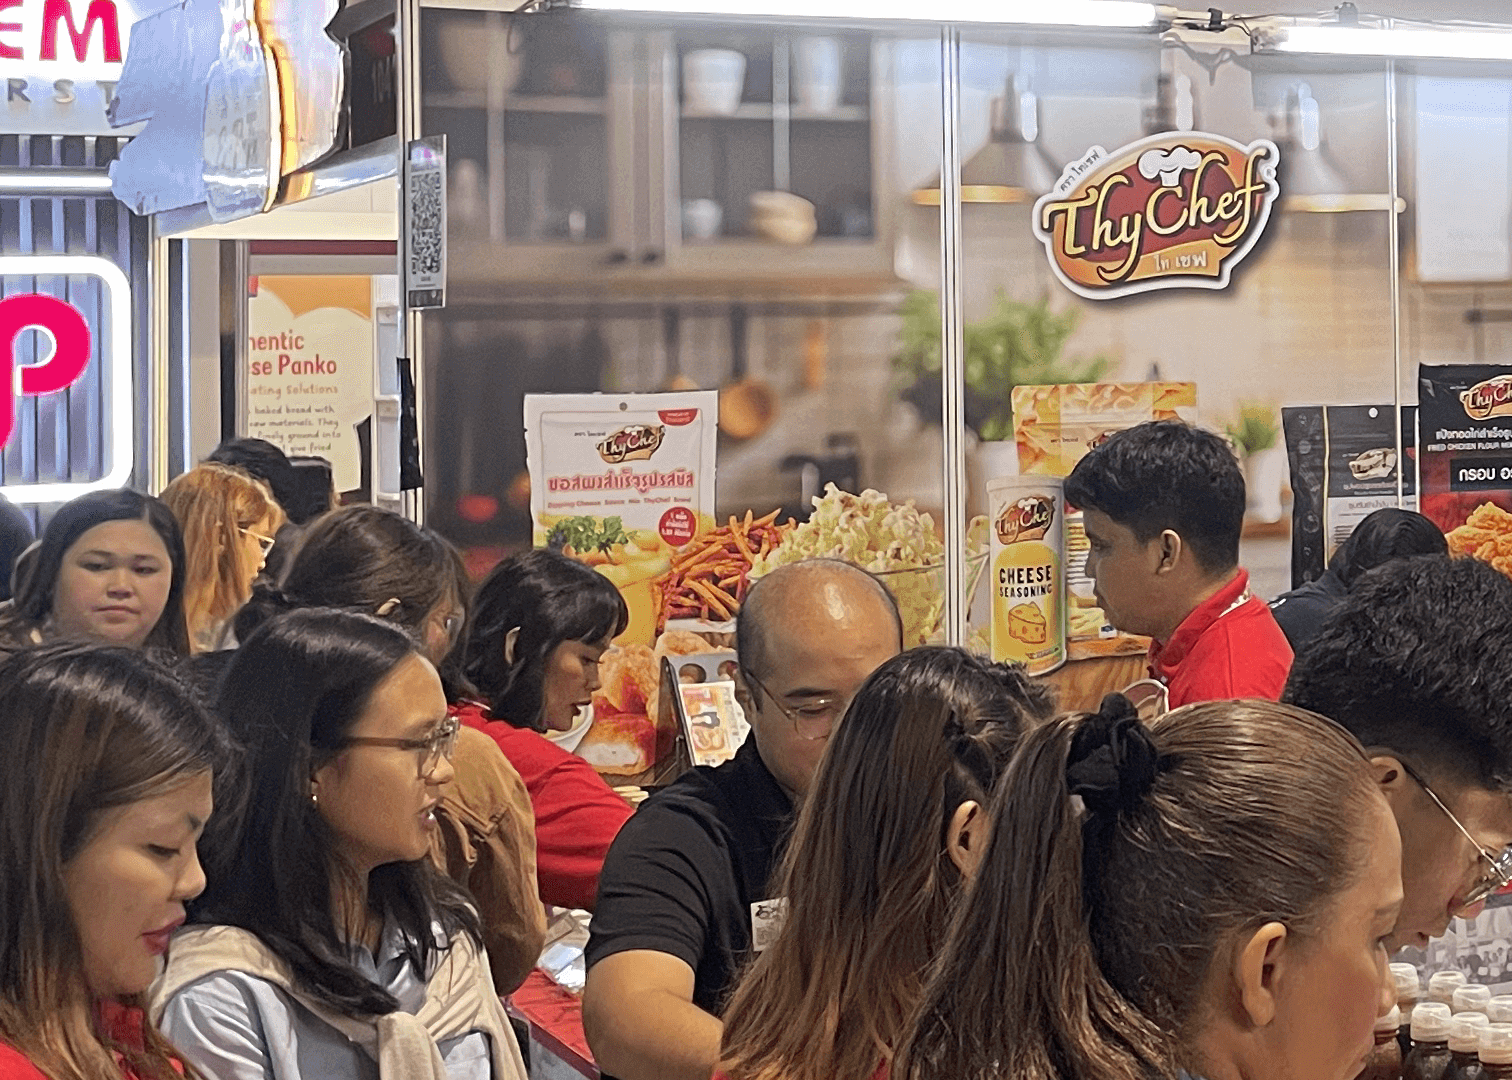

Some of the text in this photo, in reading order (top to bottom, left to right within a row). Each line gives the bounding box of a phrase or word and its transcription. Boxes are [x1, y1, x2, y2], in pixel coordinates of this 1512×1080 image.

[278, 353, 338, 376] Panko
[1458, 466, 1496, 482] กรอบ
[998, 564, 1053, 585] CHEESE
[998, 582, 1053, 599] SEASONING
